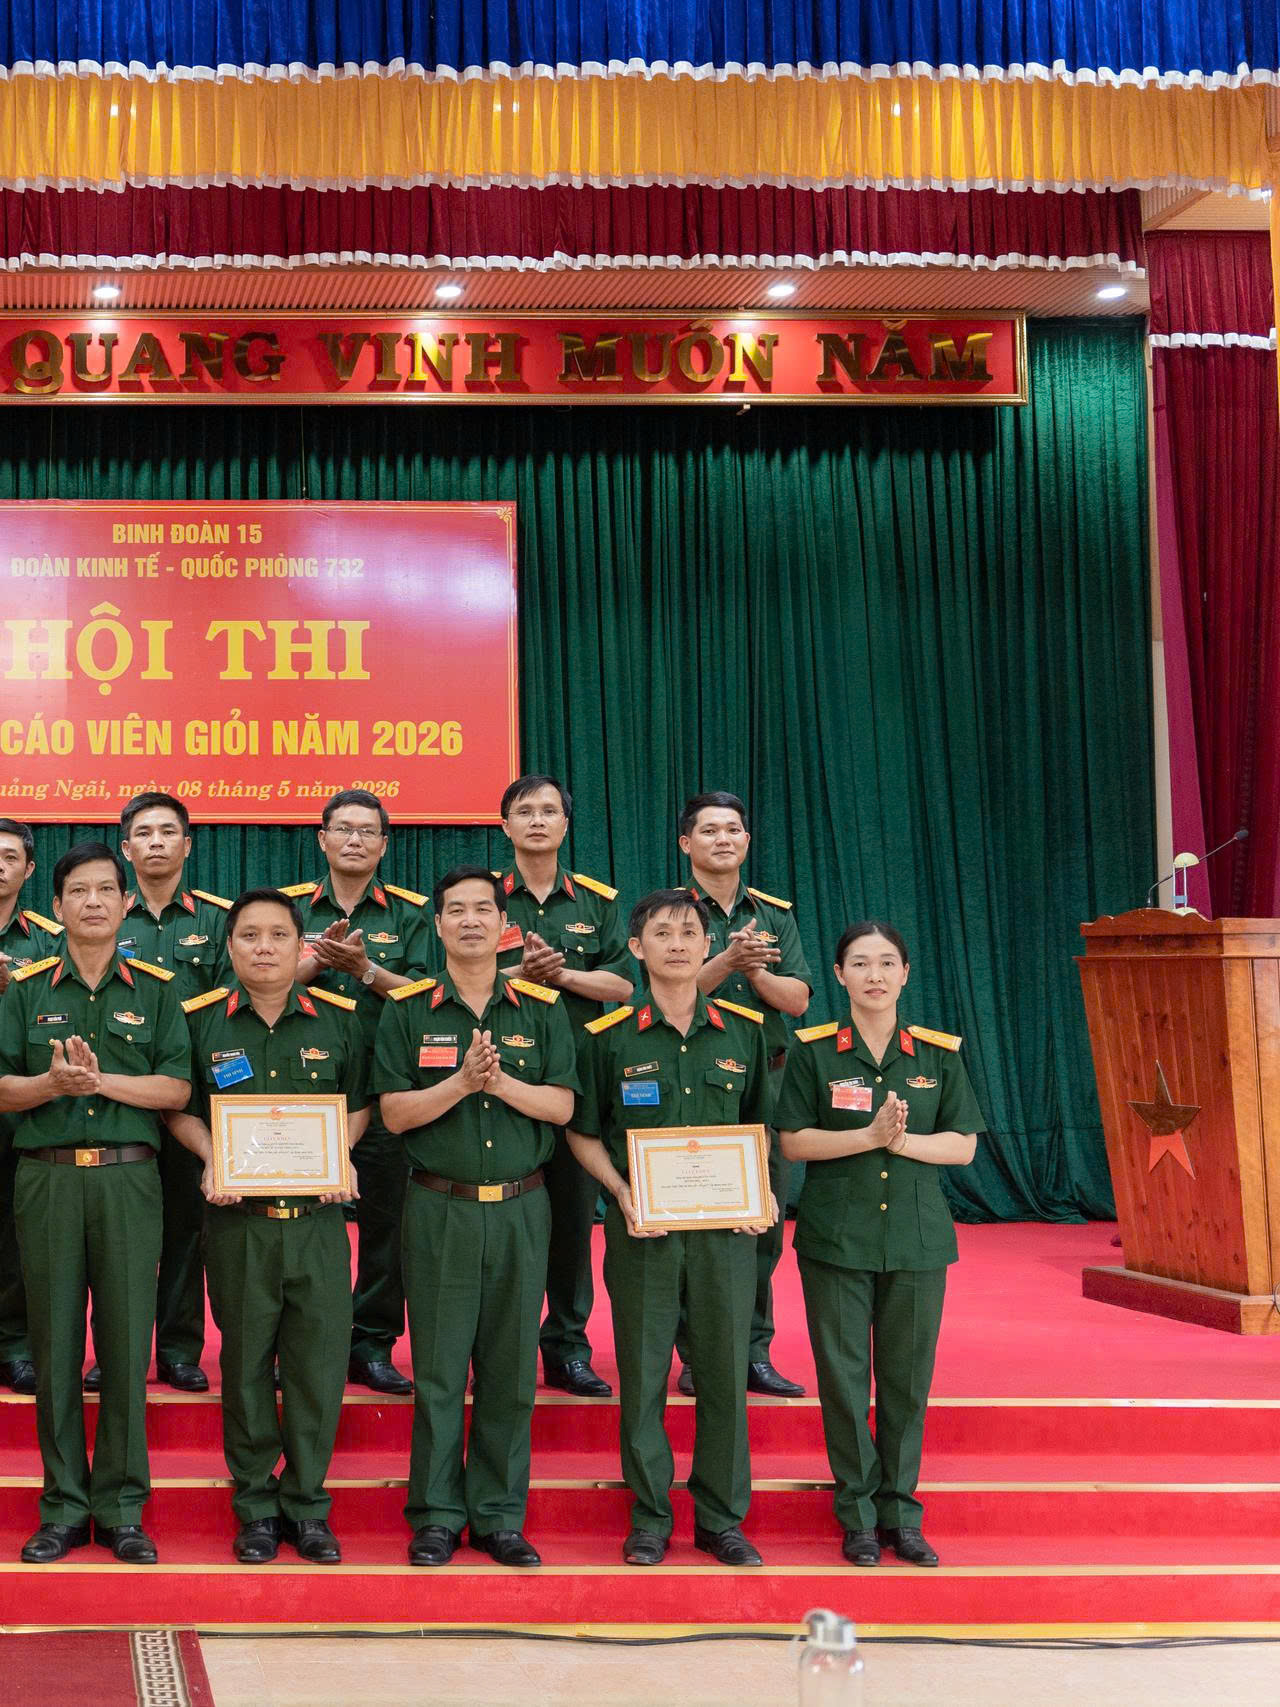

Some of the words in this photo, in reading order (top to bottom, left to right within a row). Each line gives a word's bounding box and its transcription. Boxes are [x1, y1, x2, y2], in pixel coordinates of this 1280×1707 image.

[11, 330, 286, 395] QUANG
[316, 331, 523, 382] VINH
[556, 318, 780, 383] MUÔN
[815, 319, 995, 383] NĂM
[112, 523, 165, 545] BINH
[169, 519, 230, 545] ĐOÀN
[236, 523, 263, 545] 15
[10, 552, 70, 578] ĐOÀN
[76, 557, 129, 578] KINH
[134, 551, 161, 578] TẾ
[180, 551, 239, 580] QUỐC
[245, 552, 319, 578] PHÒNG
[325, 558, 365, 578] 732
[4, 601, 174, 696] HỘI
[204, 619, 371, 681] THI
[0, 712, 75, 756] CÁO
[86, 712, 172, 756] VIÊN
[184, 708, 260, 756] GIỎI
[272, 712, 360, 756] NĂM
[371, 720, 463, 756] 2026
[55, 779, 111, 801] Ngãi,
[177, 780, 202, 798] 08
[207, 779, 272, 801] tháng
[277, 780, 291, 798] 5
[295, 780, 344, 797] năm
